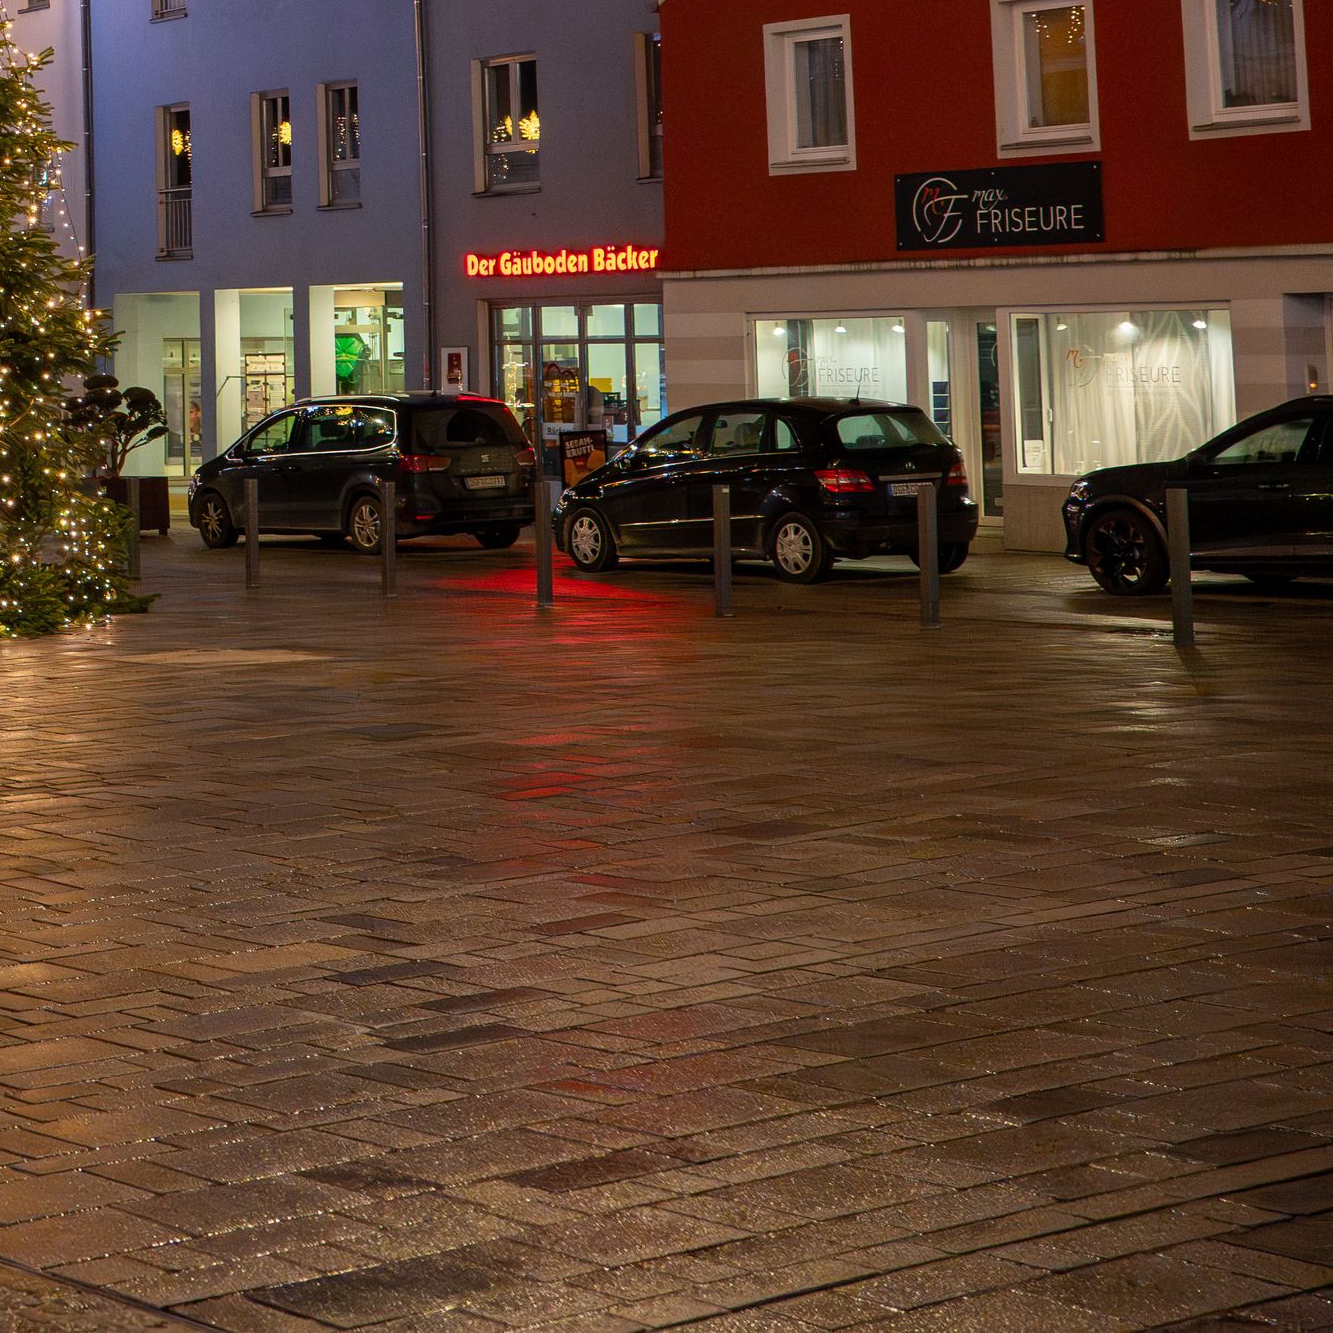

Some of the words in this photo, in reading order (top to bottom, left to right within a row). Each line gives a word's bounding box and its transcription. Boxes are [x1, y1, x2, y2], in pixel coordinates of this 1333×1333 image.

[977, 204, 1085, 234] FRISEURE
[467, 254, 496, 276] Der
[500, 250, 588, 276] Gäuboden
[593, 245, 659, 272] Bäcker
[818, 367, 880, 383] FRISEURE
[1105, 366, 1182, 383] FRISEURE
